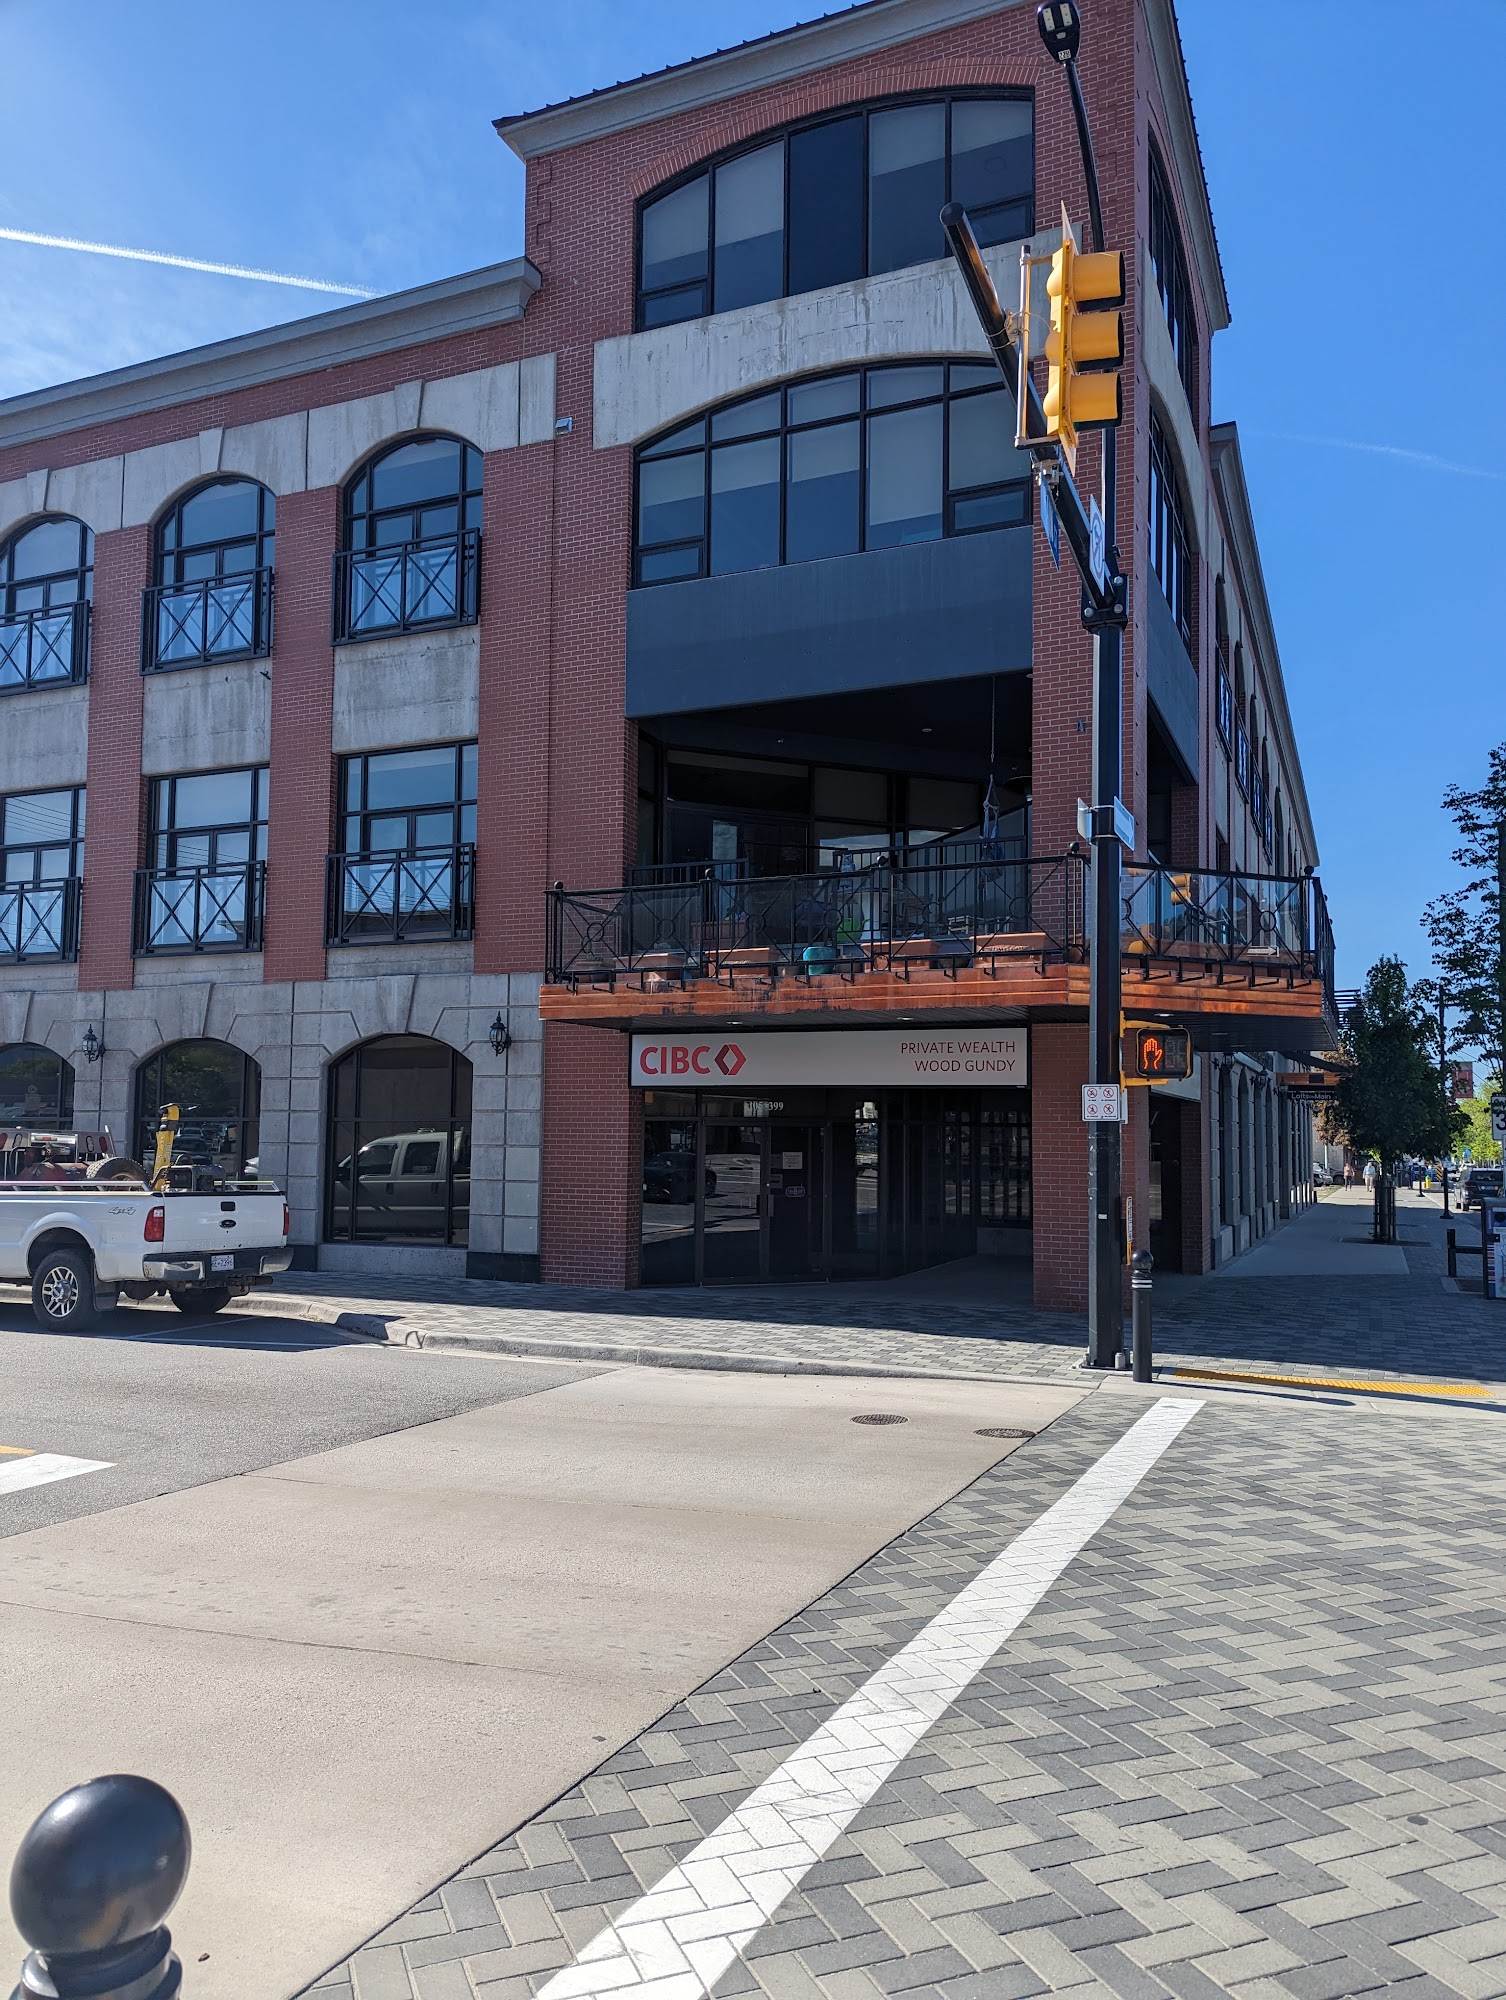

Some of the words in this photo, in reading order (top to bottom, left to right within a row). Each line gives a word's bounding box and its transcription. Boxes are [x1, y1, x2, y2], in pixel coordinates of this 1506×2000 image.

[901, 1042, 954, 1054] PRIVATE
[957, 1041, 1016, 1053] WEALTH
[640, 1045, 711, 1075] CIBC
[914, 1060, 961, 1072] WOOD
[964, 1059, 1016, 1072] GUNDY
